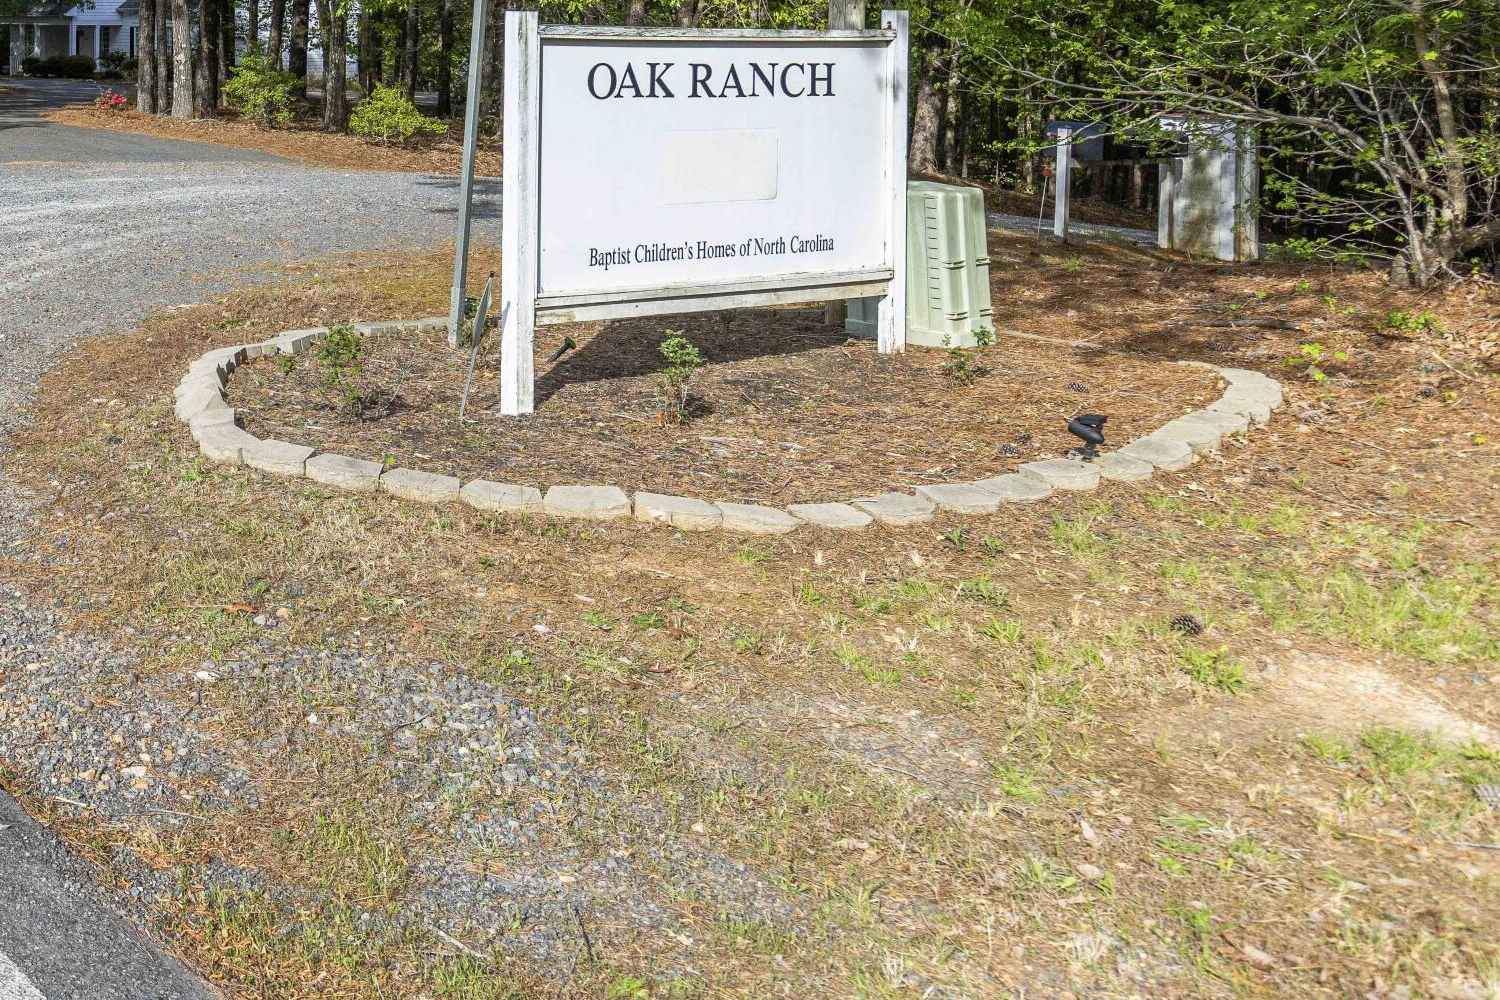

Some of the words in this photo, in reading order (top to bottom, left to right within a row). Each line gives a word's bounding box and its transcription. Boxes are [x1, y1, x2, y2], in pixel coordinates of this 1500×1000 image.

[587, 62, 675, 100] OAK
[688, 62, 837, 98] RANCH
[589, 247, 631, 271] Baptist
[635, 241, 694, 264] Children's
[696, 240, 736, 260] Homes
[739, 238, 752, 257] of
[753, 236, 786, 256] North
[790, 234, 835, 254] Carolina
